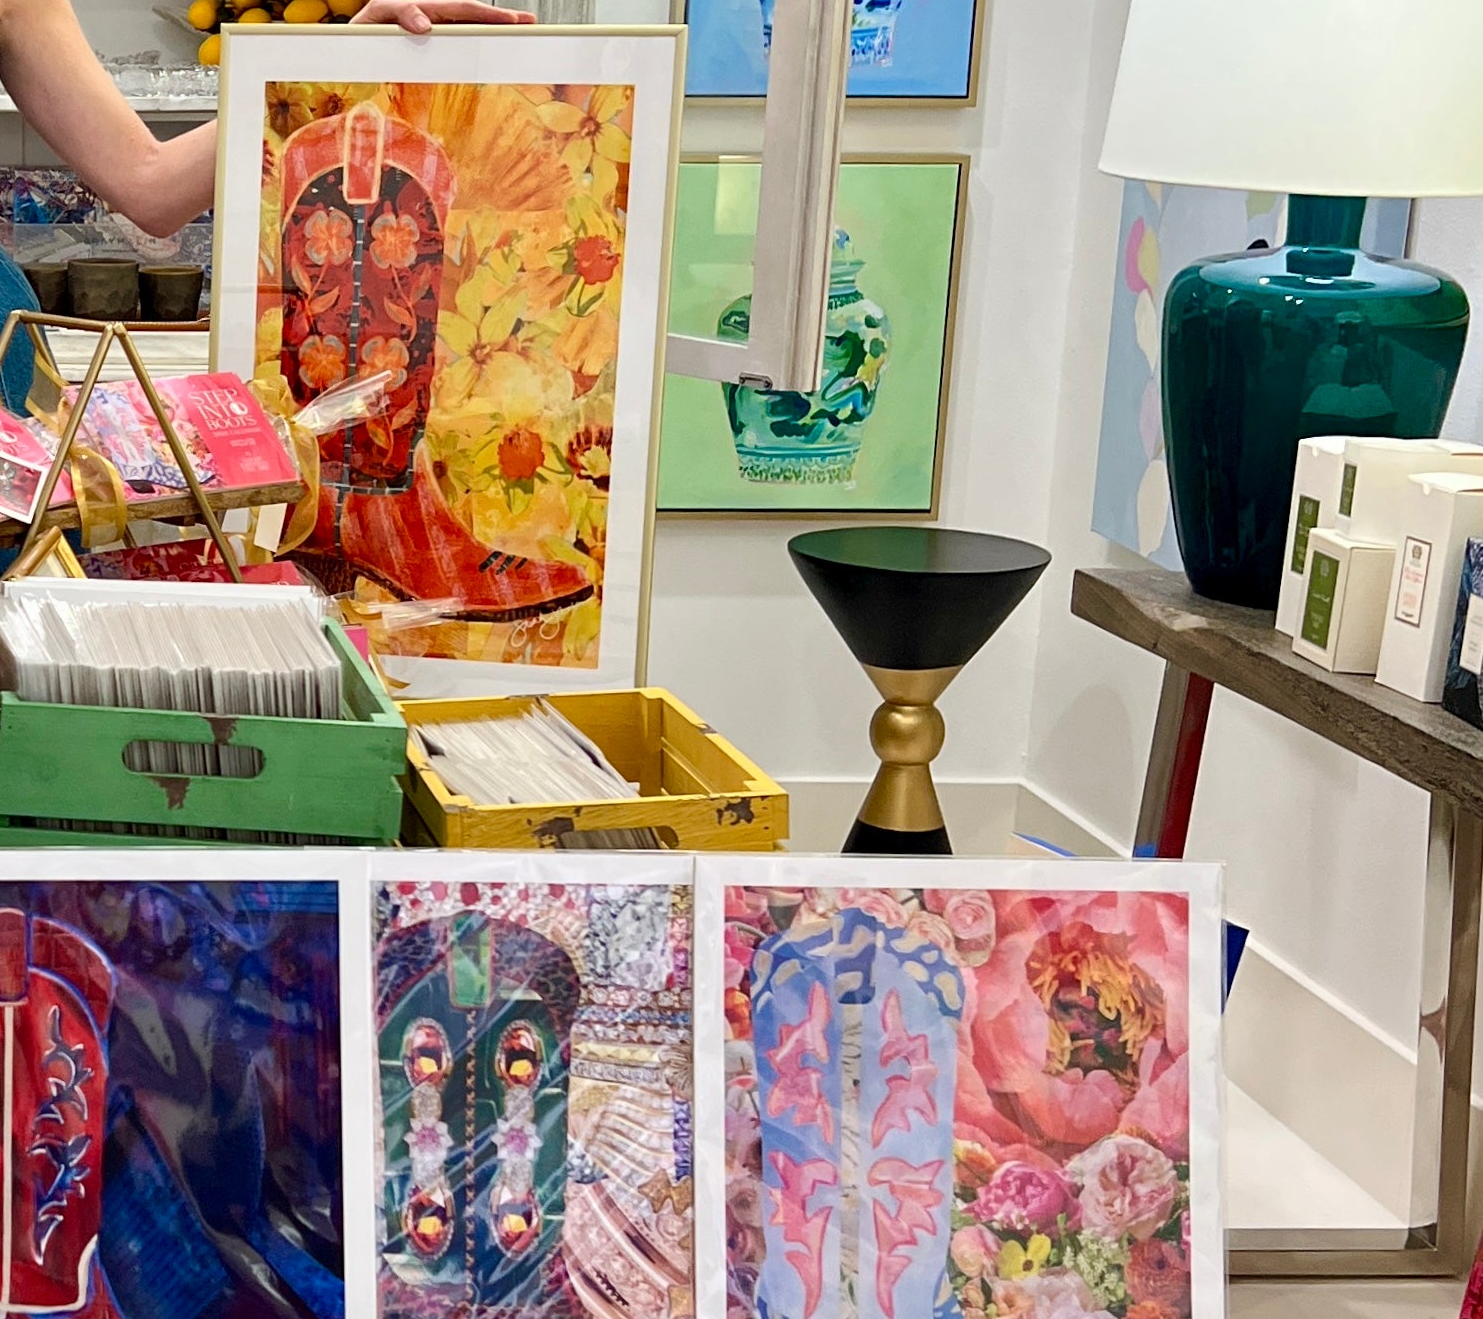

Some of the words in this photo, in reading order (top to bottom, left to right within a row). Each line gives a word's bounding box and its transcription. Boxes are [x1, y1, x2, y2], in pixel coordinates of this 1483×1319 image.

[187, 388, 238, 406] STEP
[197, 401, 249, 420] INTO
[204, 414, 257, 431] BOOTS
